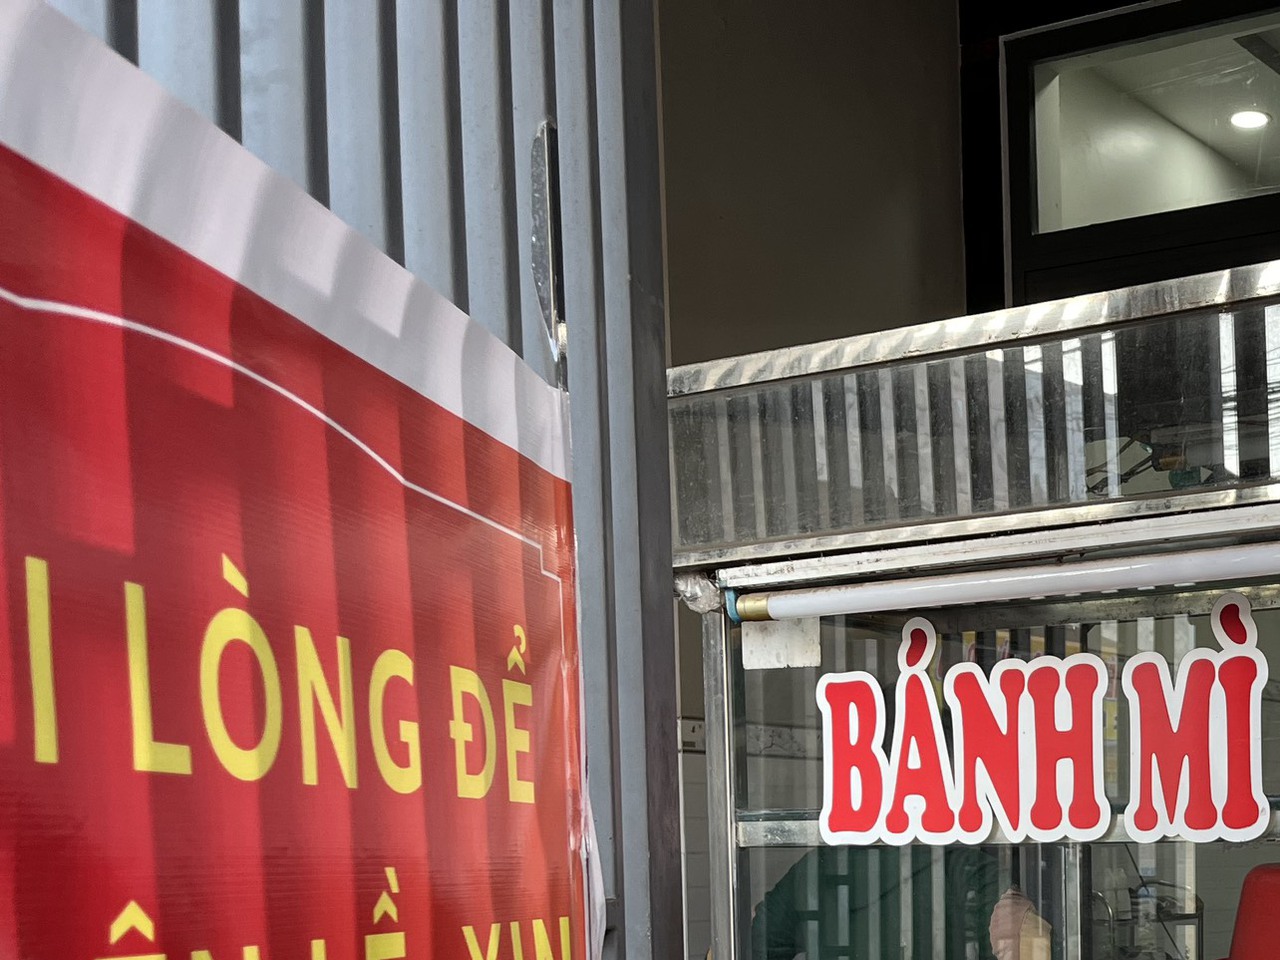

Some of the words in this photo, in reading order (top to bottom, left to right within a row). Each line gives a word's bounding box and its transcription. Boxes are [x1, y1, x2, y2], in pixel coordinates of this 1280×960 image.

[124, 552, 423, 795] LÒNG
[448, 624, 536, 804] ĐỂ
[821, 623, 1105, 838] BÁNH
[1127, 598, 1261, 836] MÌ
